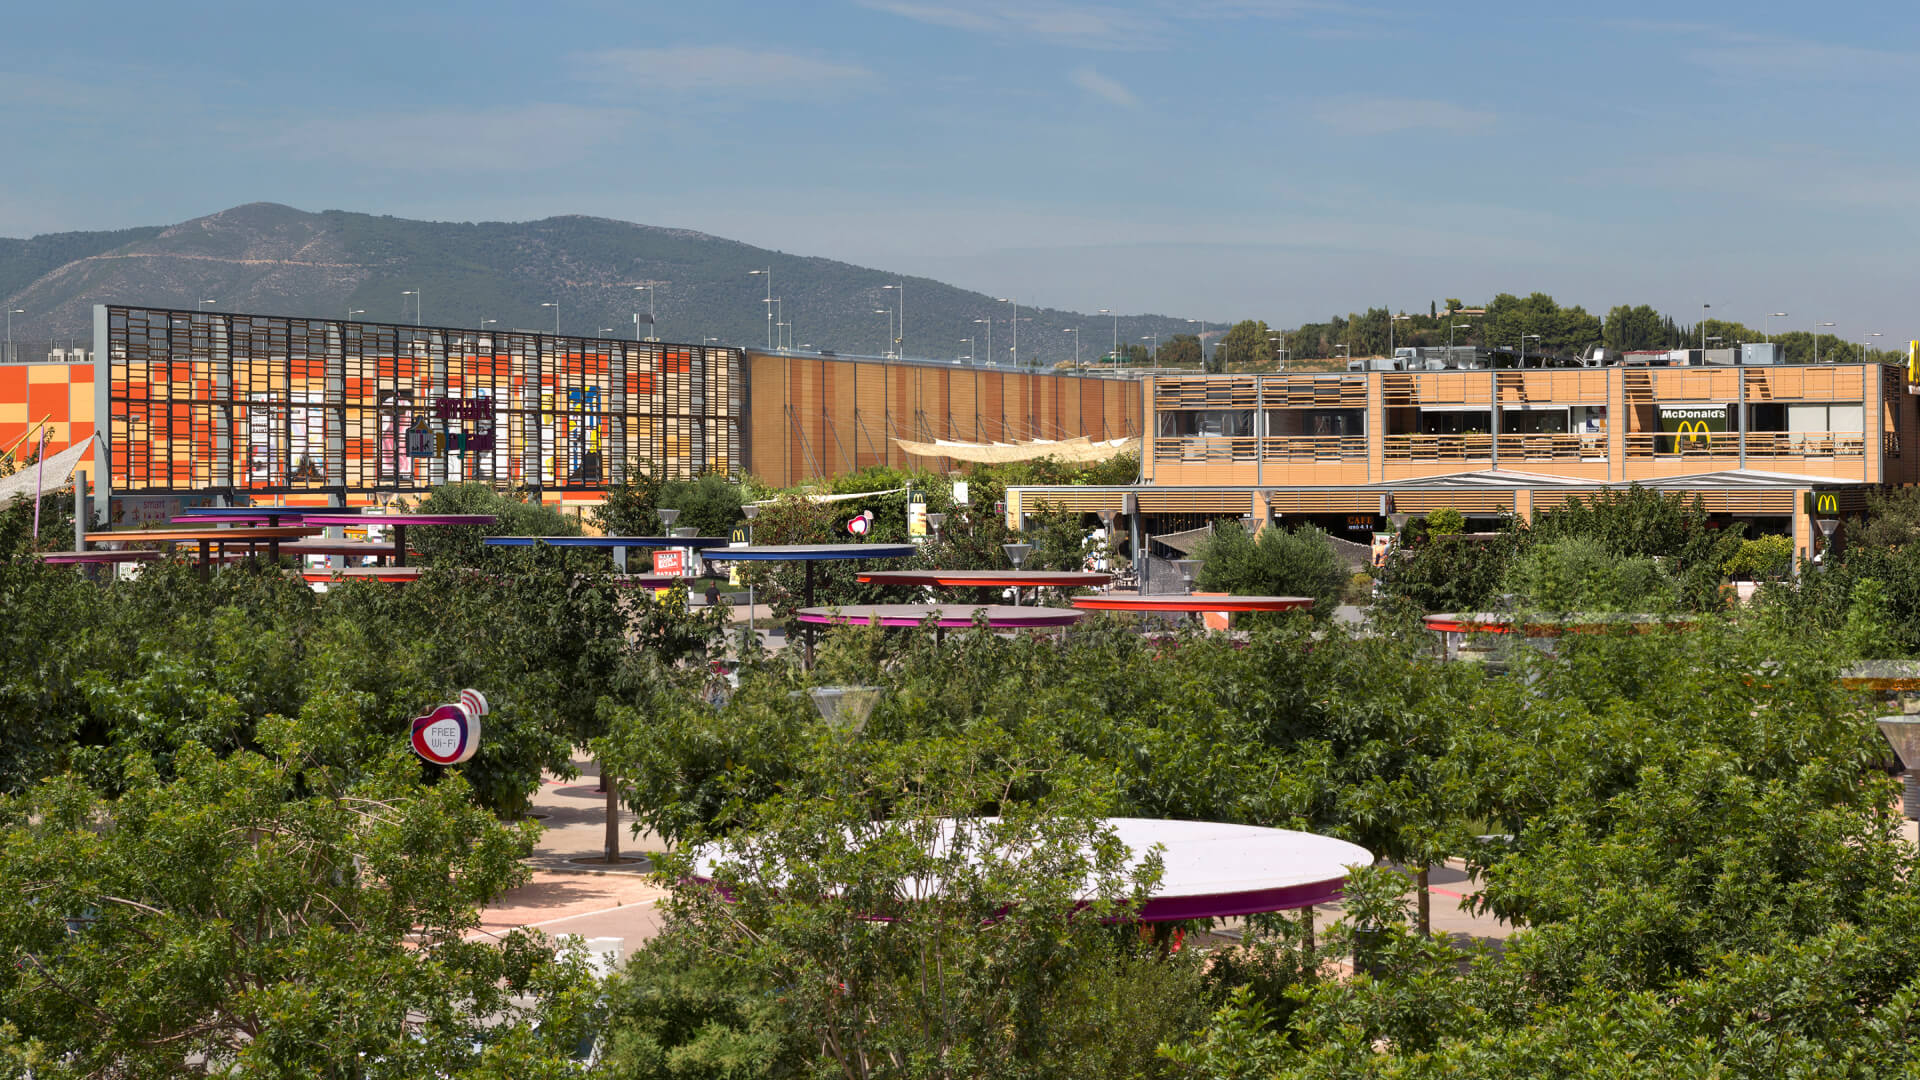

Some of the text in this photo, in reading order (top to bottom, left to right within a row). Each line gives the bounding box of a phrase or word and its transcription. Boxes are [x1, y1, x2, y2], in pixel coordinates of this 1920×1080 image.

[437, 396, 490, 418] smart
[1661, 410, 1726, 419] McDonald's
[431, 727, 456, 737] FREE
[431, 738, 456, 748] Wi-Fi
